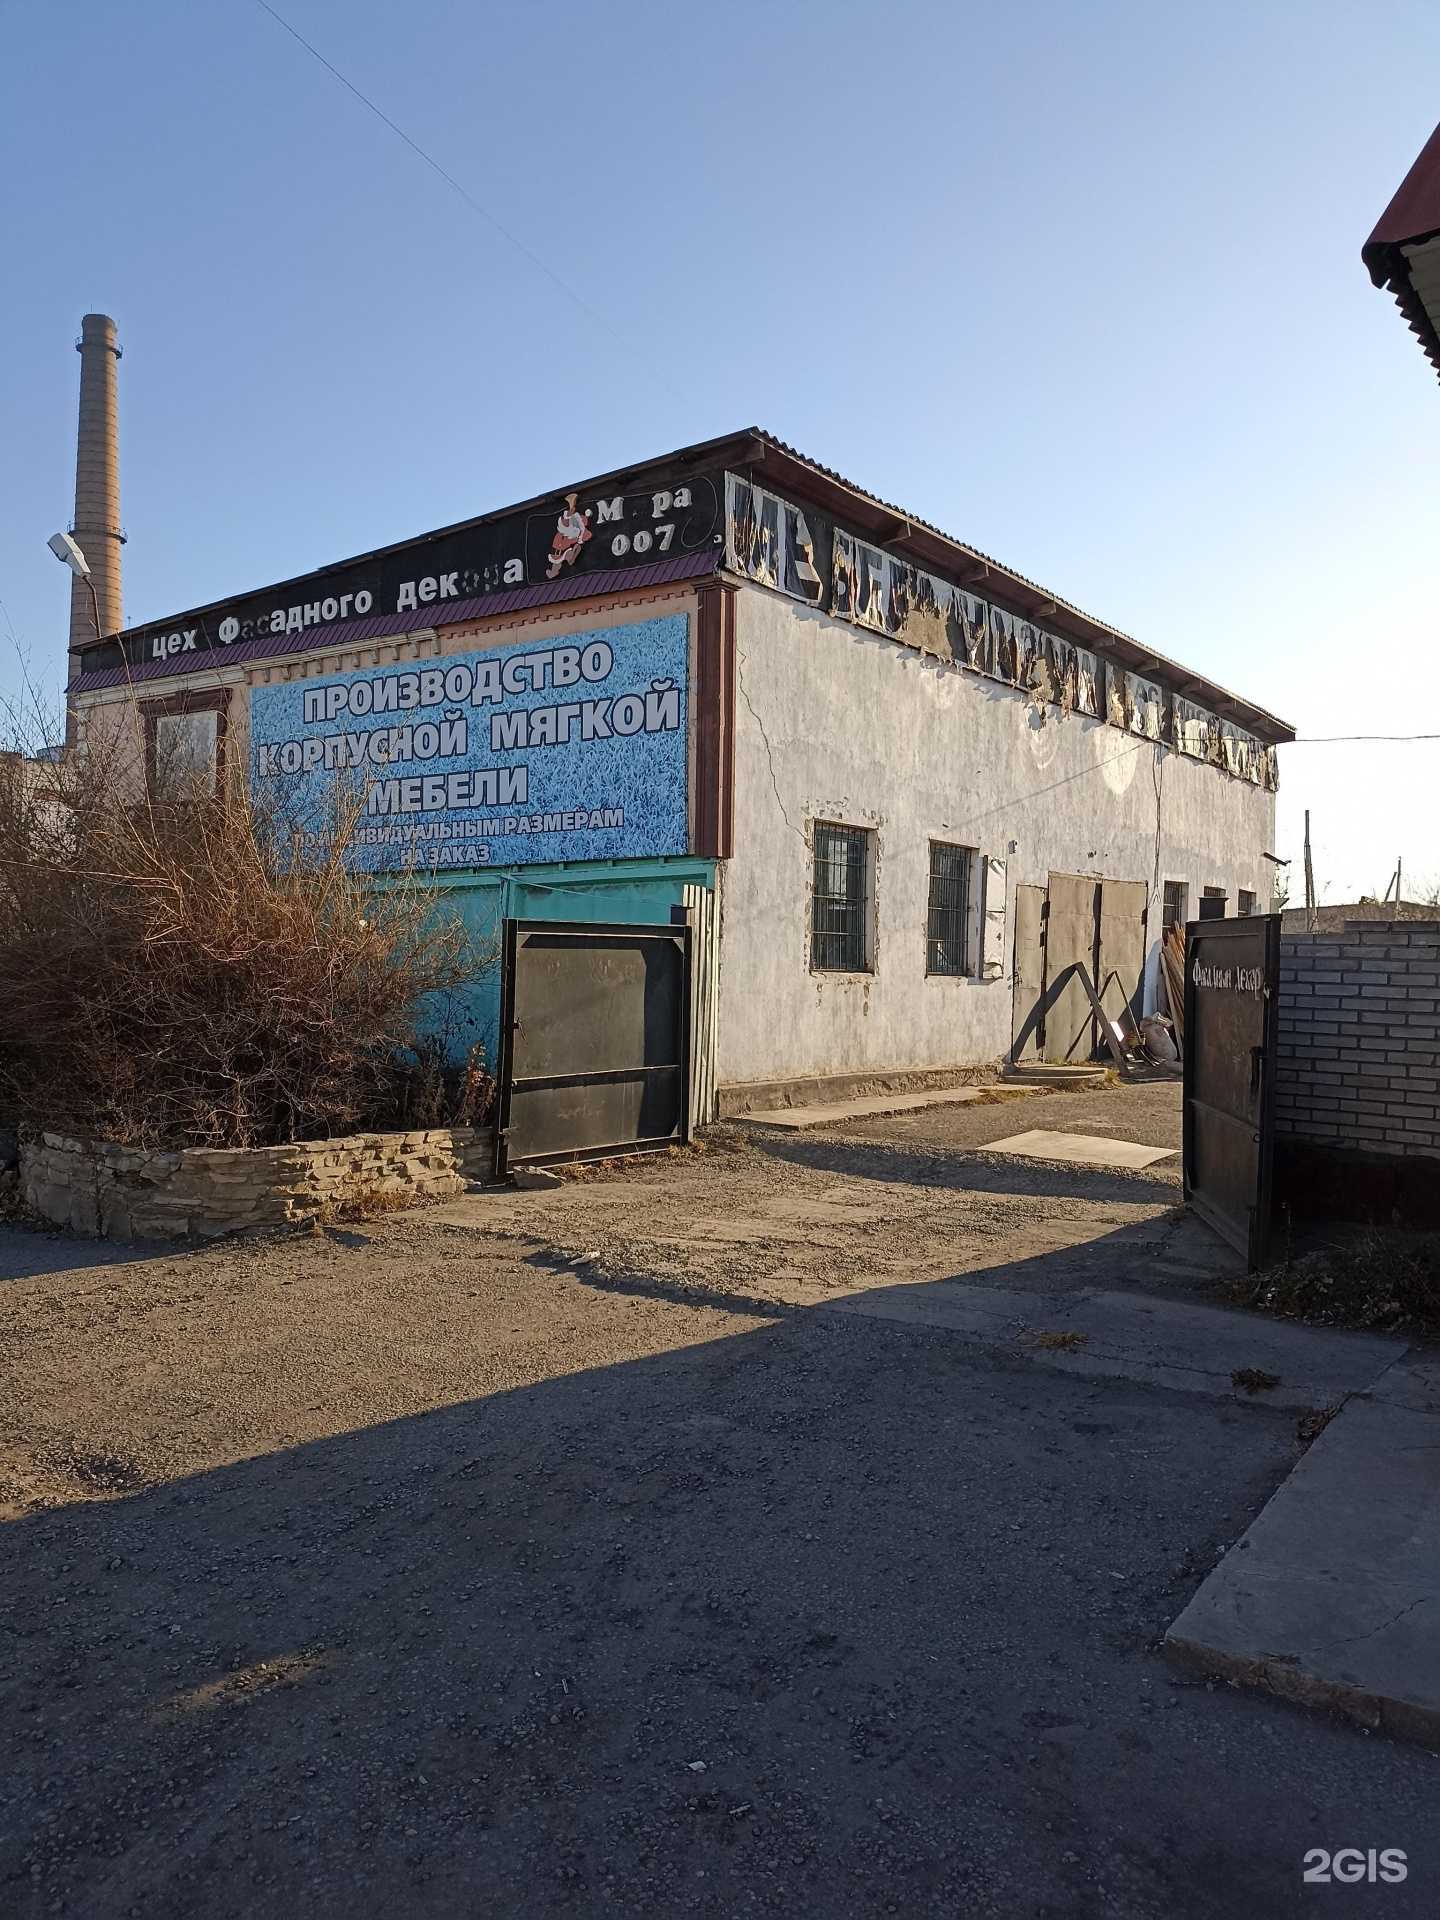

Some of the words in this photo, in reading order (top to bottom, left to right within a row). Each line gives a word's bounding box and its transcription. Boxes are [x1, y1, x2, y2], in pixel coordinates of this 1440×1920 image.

[611, 523, 675, 556] 007
[152, 629, 198, 660] цех
[396, 558, 524, 613] дека
[304, 640, 614, 724] ПРОИЗВОДСТВО
[257, 708, 468, 777] КОРПУСНОЙ
[491, 677, 681, 752] МЯГКОЙ
[367, 766, 528, 816] МЕБЕЛИ
[504, 808, 624, 836] РАЗМЕРАМ
[400, 846, 426, 866] НА
[428, 844, 490, 865] ЗАКАЗ
